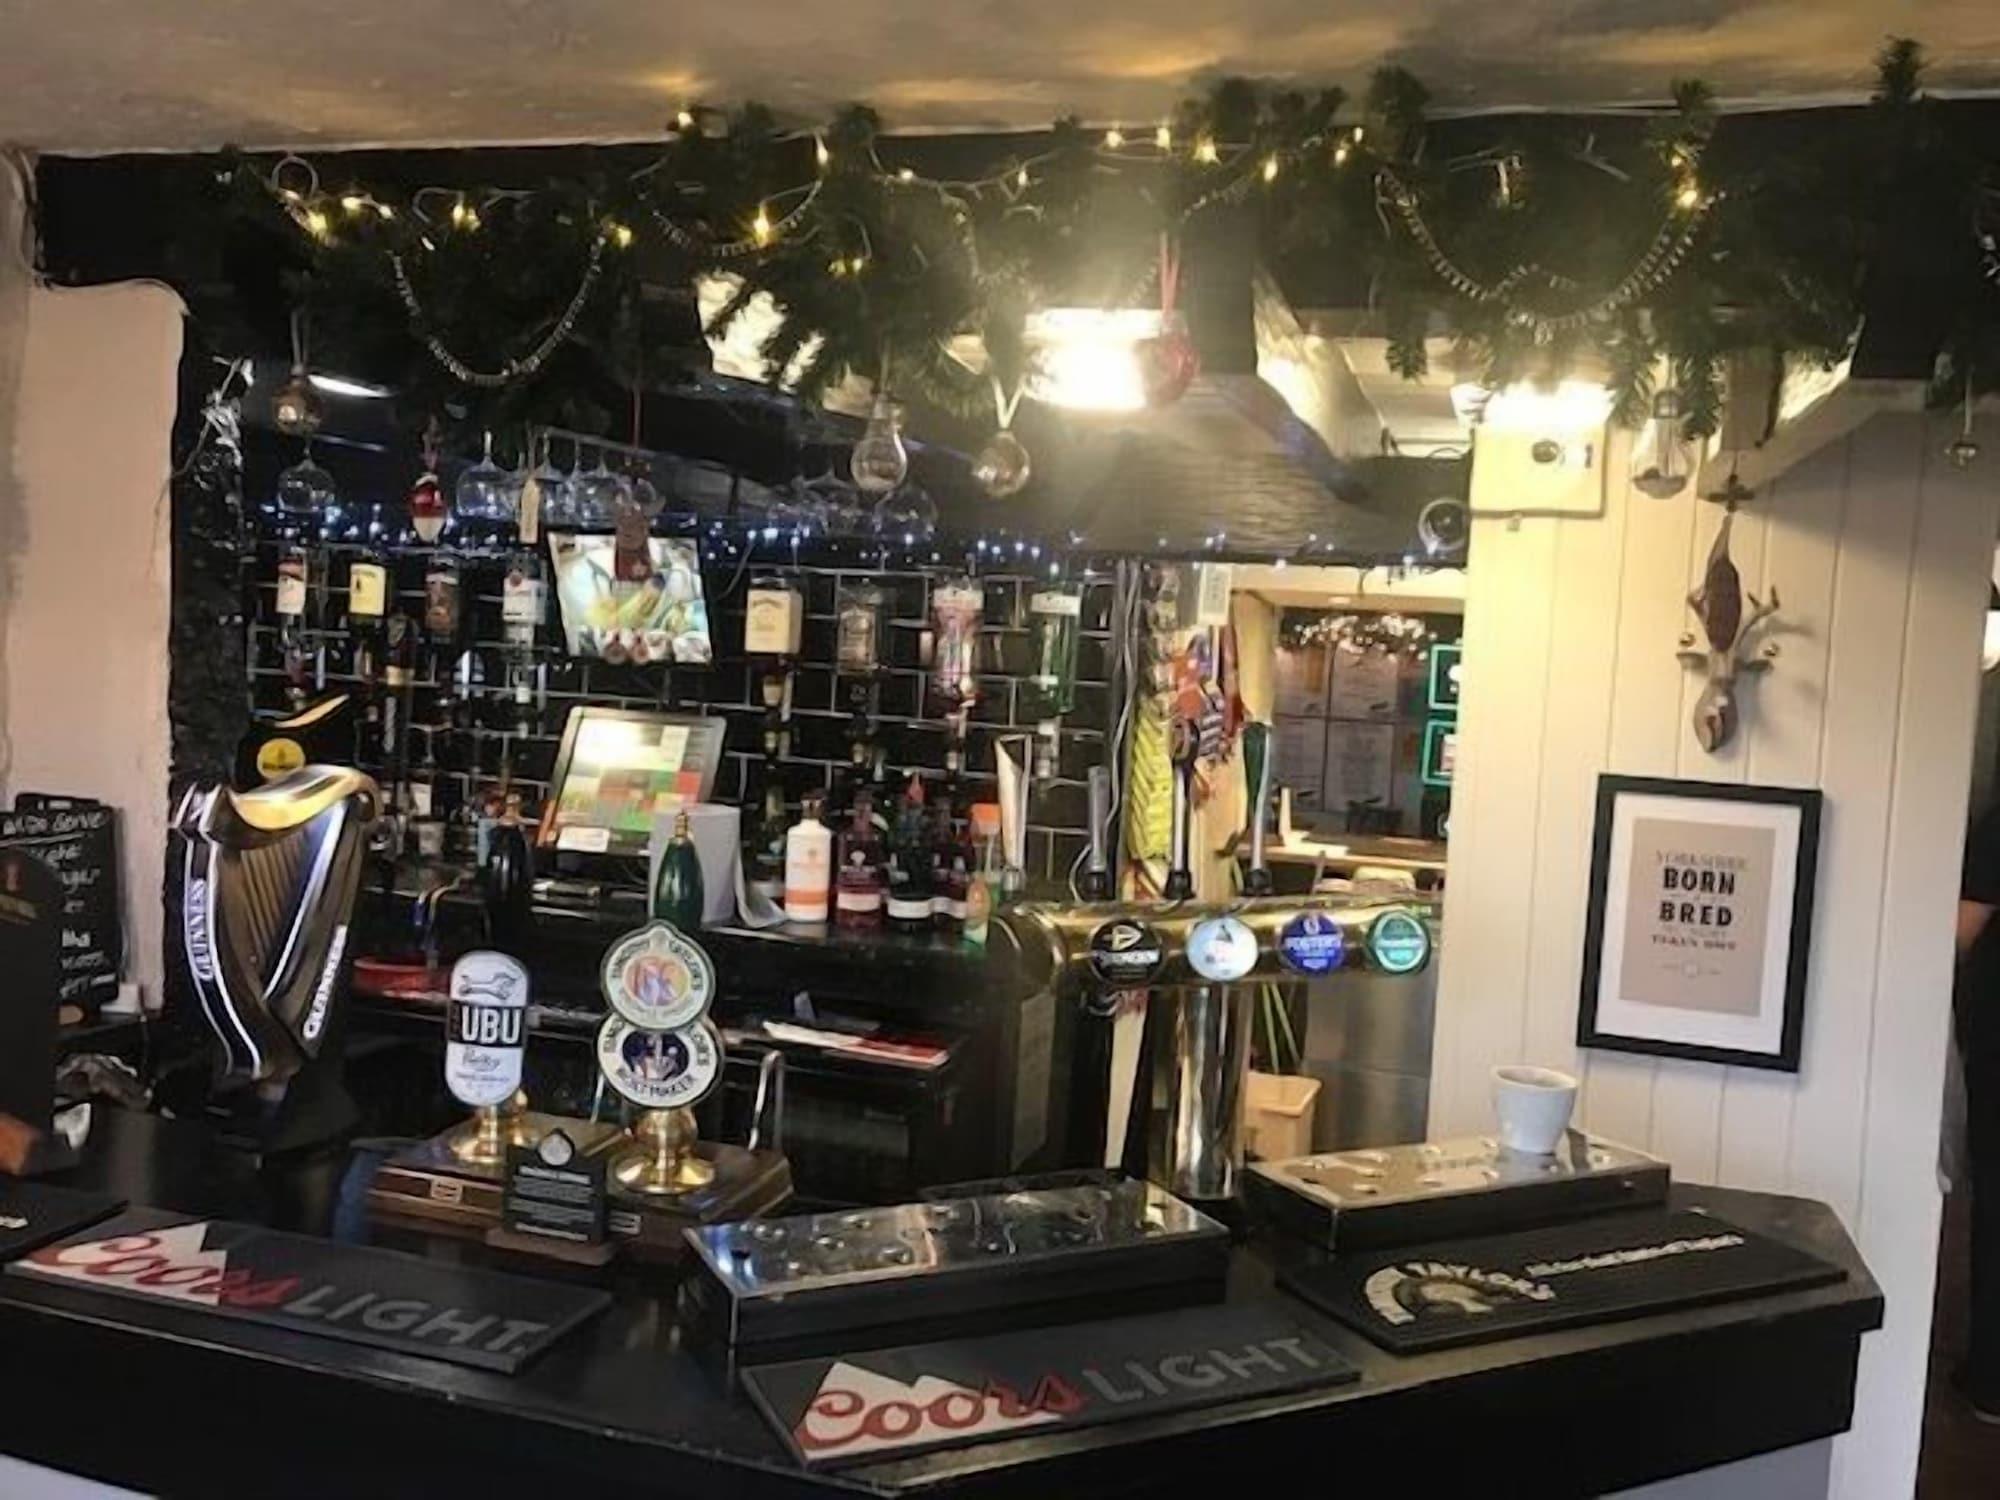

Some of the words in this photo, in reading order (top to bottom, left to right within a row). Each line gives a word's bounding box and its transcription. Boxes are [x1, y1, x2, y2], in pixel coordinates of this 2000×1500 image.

[1662, 866, 1736, 895] BORN
[1659, 900, 1733, 927] BRED
[461, 1003, 523, 1045] UBU
[24, 1234, 300, 1310] Coors
[284, 1284, 550, 1353] LIGHT
[794, 1370, 1088, 1451] Coors
[1084, 1337, 1322, 1403] LIGHT
